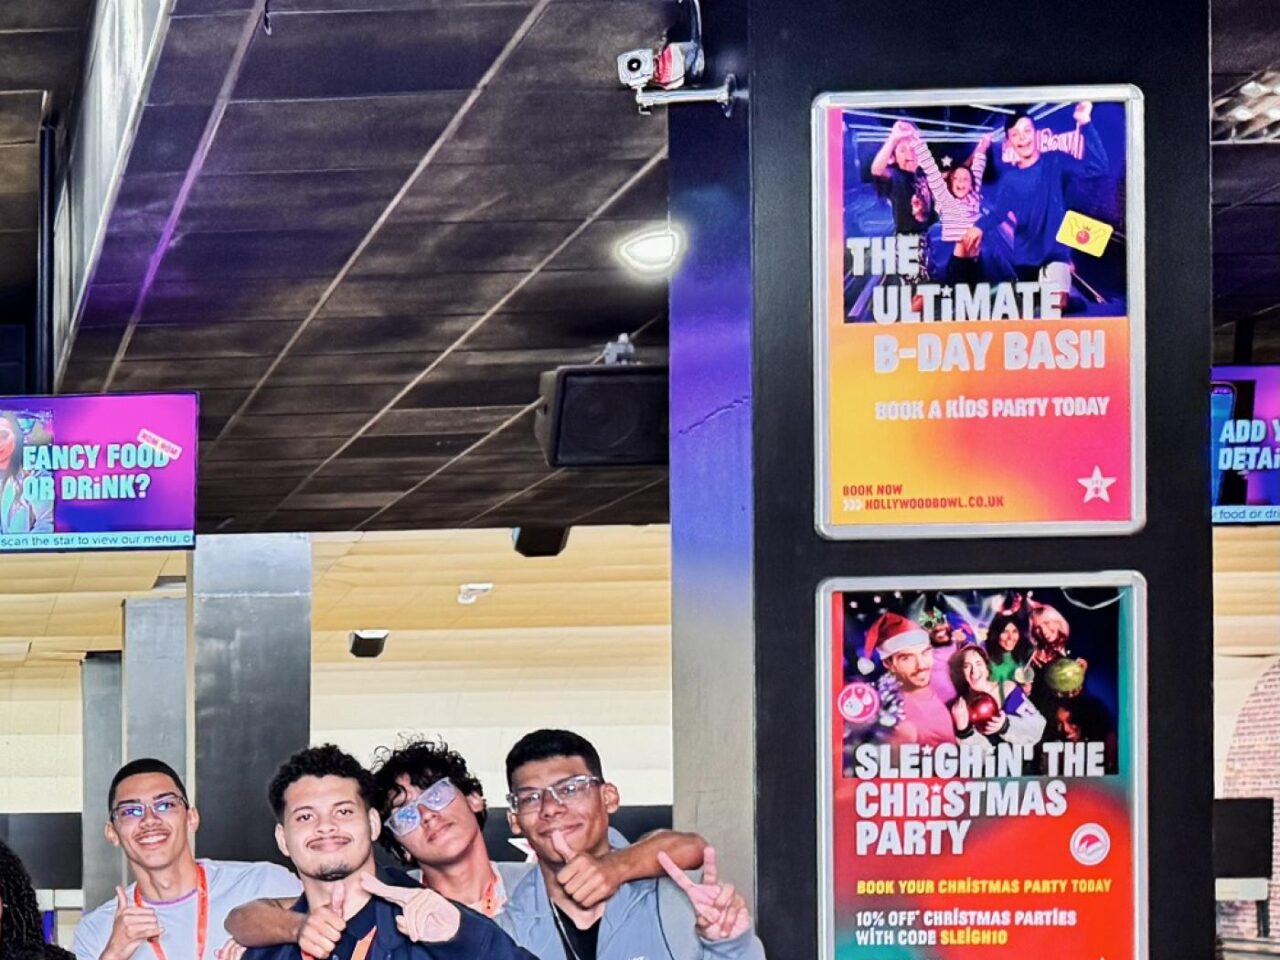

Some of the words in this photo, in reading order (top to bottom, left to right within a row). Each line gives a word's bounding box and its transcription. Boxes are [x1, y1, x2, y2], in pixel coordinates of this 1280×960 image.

[846, 235, 919, 275] THE
[874, 331, 992, 373] B-DAY
[1004, 330, 1105, 371] BASH
[875, 401, 924, 420] BOOK
[928, 400, 942, 419] A
[992, 398, 1048, 418] PARTY
[1052, 396, 1110, 416] TODAY
[1219, 419, 1266, 444] ADD
[23, 444, 100, 470] FANCY
[107, 443, 170, 469] FOOD
[23, 476, 55, 500] OR
[842, 485, 873, 497] BOOK
[877, 484, 903, 495] NOW
[865, 496, 1004, 511] HOLLYWOODBOWL.CO.UK
[1220, 510, 1246, 519] food
[1249, 511, 1262, 519] or
[1, 537, 29, 546] scan
[32, 535, 49, 546] the
[53, 535, 75, 546] star
[77, 535, 90, 545] to
[92, 535, 119, 545] view
[121, 536, 140, 545] our
[1043, 741, 1105, 778] THE
[856, 819, 971, 856] PARTY
[856, 880, 895, 895] BOOK
[899, 879, 934, 894] YOUR
[1023, 879, 1067, 894] PARTY
[1072, 878, 1112, 893] TODAY
[856, 911, 885, 928] 10%
[898, 930, 936, 945] CODE
